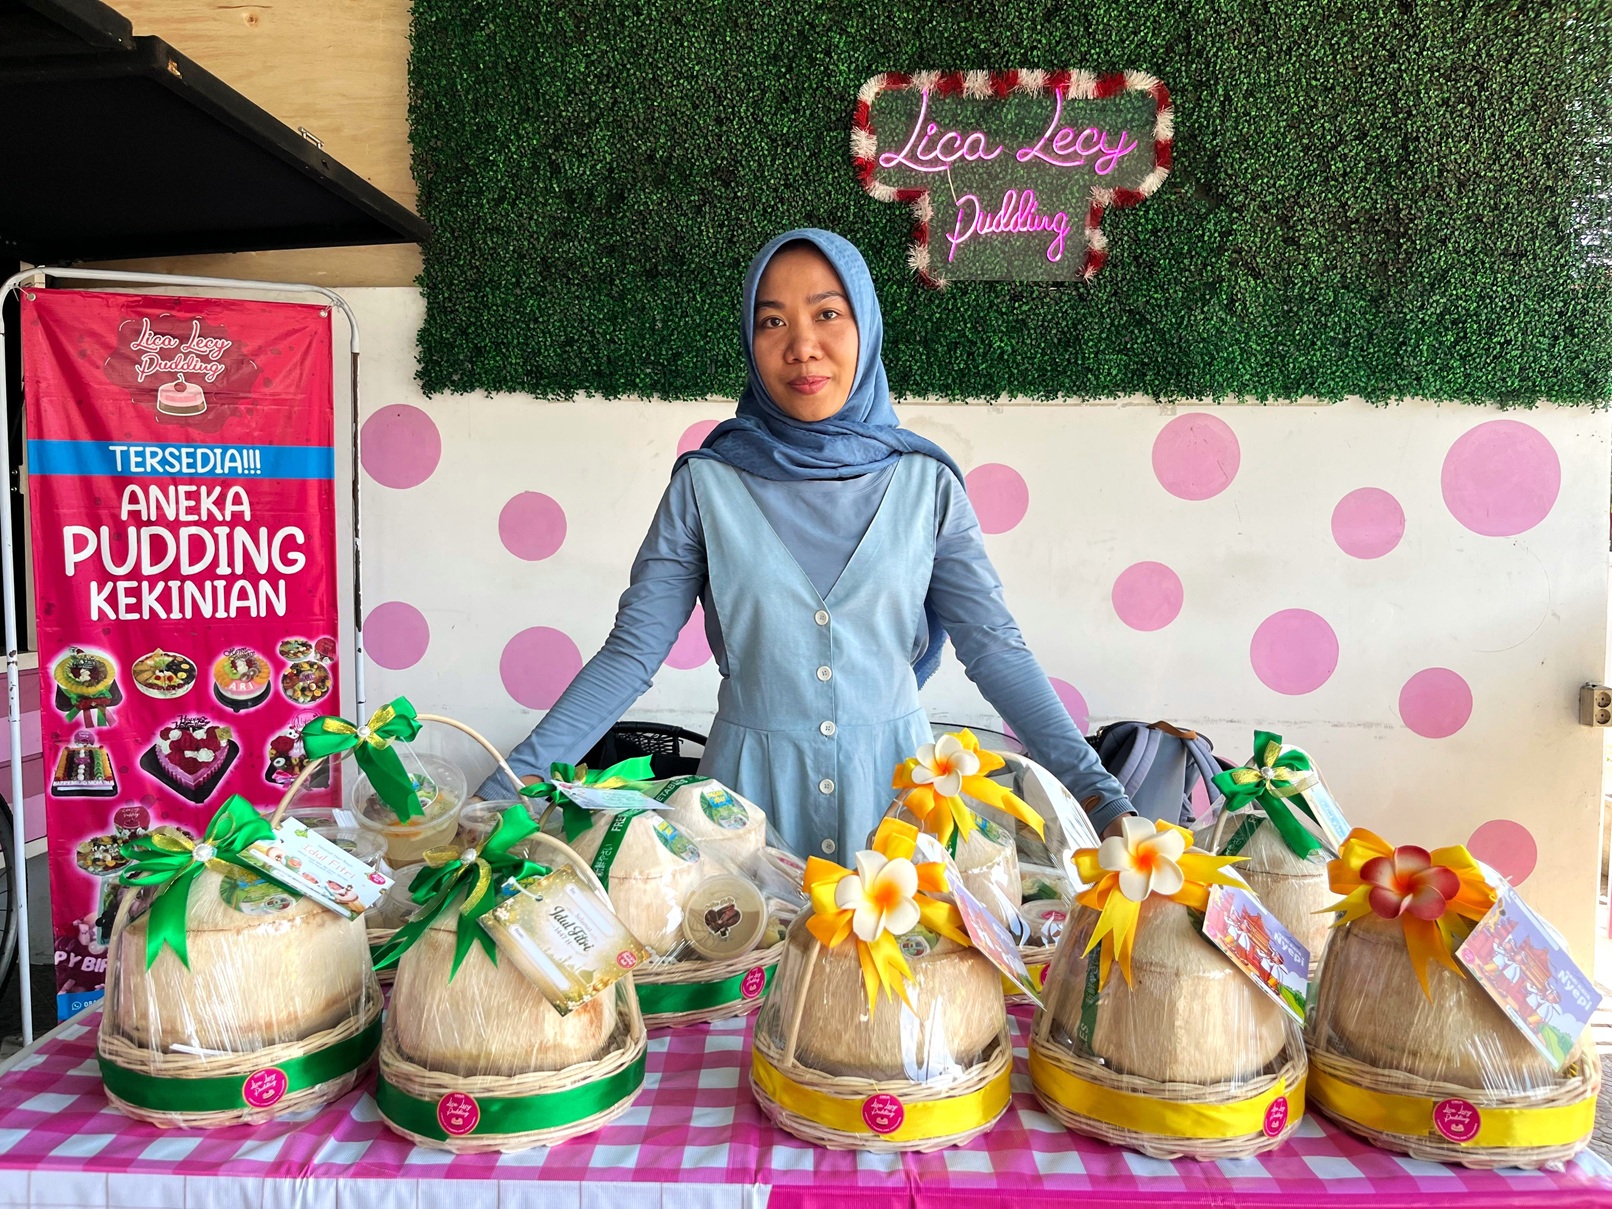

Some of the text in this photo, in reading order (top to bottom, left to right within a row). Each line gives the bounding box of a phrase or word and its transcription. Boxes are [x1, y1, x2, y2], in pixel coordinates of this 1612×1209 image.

[879, 87, 1138, 176] Lica Lecy
[945, 189, 1071, 263] Pudding
[130, 317, 232, 360] Lica Lecy
[135, 352, 225, 383] Pudding
[109, 445, 262, 475] TERSEDIA!!!
[120, 485, 252, 522] ANEKA
[63, 525, 306, 577] PUDDING
[89, 579, 287, 621] KEKINIAN
[228, 682, 254, 691] ARI
[301, 843, 327, 860] Idul
[328, 859, 355, 878] Fitri
[549, 905, 594, 952] Idul Fitri
[574, 912, 593, 933] Selamat
[1273, 932, 1305, 967] Nyepi
[1557, 969, 1592, 1010] Nyepi
